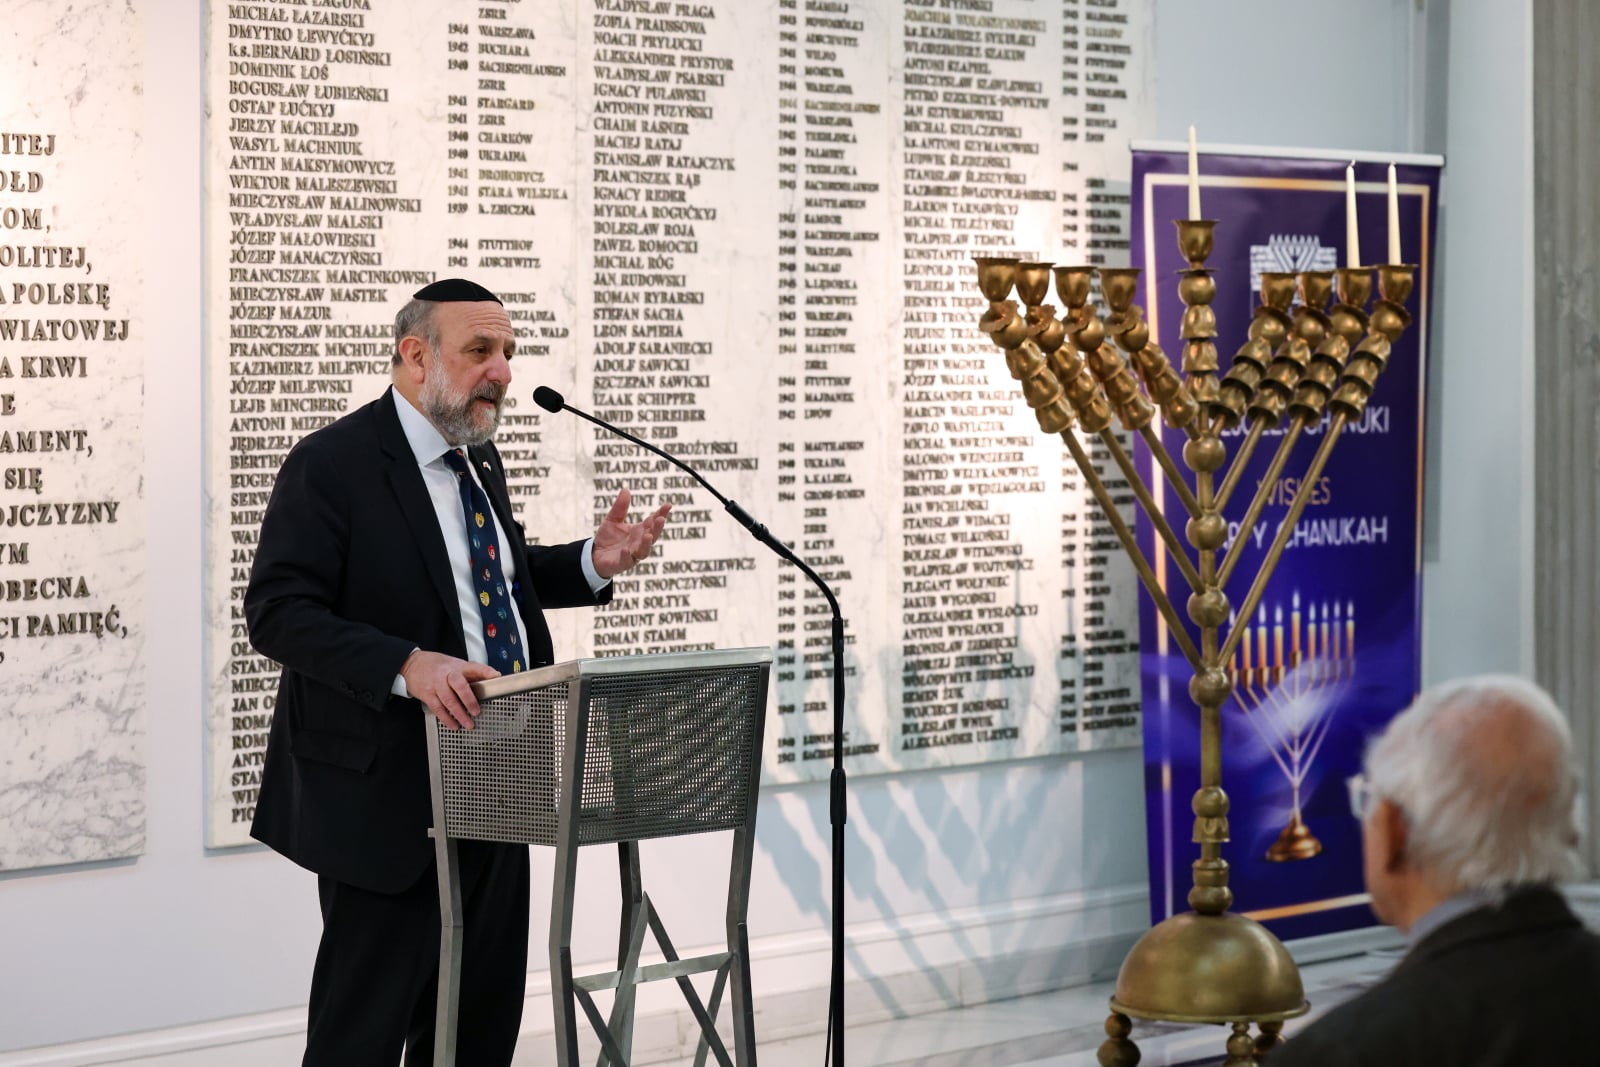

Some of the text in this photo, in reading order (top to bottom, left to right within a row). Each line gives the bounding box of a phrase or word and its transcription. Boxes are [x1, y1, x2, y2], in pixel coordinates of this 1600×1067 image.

[229, 4, 288, 22] MICHAŁ
[292, 9, 365, 28] ŁAZARSKI
[675, 7, 716, 19] PRAGA
[228, 23, 293, 42] DMYTRO
[478, 25, 535, 40] WARSZAWA
[593, 31, 637, 47] NOACH
[326, 49, 391, 66] ŁOSIŃSKI
[478, 43, 530, 58] BUCHARA
[594, 49, 734, 71] ALEKSANDER PRYSTOR
[229, 61, 296, 79] DOMINIK
[675, 71, 725, 86] PSARSKI
[229, 80, 389, 103] BOGUSŁAW ŁUBIEŃSKI
[593, 83, 641, 98] IGNACY
[229, 99, 276, 114] OSTAP
[477, 97, 536, 111] STARGARD
[594, 100, 649, 115] ANTONIN
[229, 117, 359, 137] JERZY MACHLEJD
[1, 133, 56, 156] ITEJ
[230, 136, 363, 156] WASYL MACHNIUK
[594, 135, 682, 151] MACIEJ RATAJ
[478, 149, 527, 162] UKRAINA
[593, 152, 736, 170] STANISŁAW RATAJCZYK
[230, 155, 396, 175] ANTIN MAKSYMOWYCZ
[229, 174, 397, 194] WIKTOR MALESZEWSKI
[478, 169, 545, 183] DROHOBYCZ
[478, 186, 513, 198] STARA
[593, 187, 686, 202] IGNACY REDER
[229, 193, 422, 213] MIECZYSŁAW MALINOWSKI
[0, 207, 51, 233] OM,
[230, 212, 383, 230] WŁADYSŁAW MALSKI
[230, 230, 276, 245] JÓZEF
[664, 223, 695, 237] ROJA
[0, 245, 93, 275] OLITEJ,
[230, 249, 382, 266] JÓZEF MANACZYŃSKI
[478, 256, 541, 268] AUSCHWITZ
[229, 268, 437, 285] FRANCISZEK MARCINKOWSKI
[593, 273, 686, 287] JAN RUDOWSKI
[12, 283, 110, 310] POLSKĘ
[230, 287, 388, 302] MIECZYSŁAW MASTEK
[593, 291, 705, 304] ROMAN RYBARSKI
[229, 305, 332, 320] JÓZEF MAZUR
[593, 307, 684, 320] STEFAN SACHA
[0, 319, 130, 341] WIATOWEJ
[230, 324, 322, 339] MIECZYSŁAW
[229, 343, 320, 357] FRANCISZEK
[21, 356, 88, 378] KRWI
[230, 361, 390, 376] KAZIMIERZ MILEWICZ
[593, 360, 690, 372] ADOLF SAWICKI
[230, 379, 353, 394] JÓZEF MILEWSKI
[230, 397, 348, 413] LEJB MINCBERG
[637, 393, 696, 405] SCHIPPER
[230, 417, 286, 432] ANTONI
[229, 436, 292, 451] JĘDRZEJ
[5, 467, 43, 494] SIĘ
[594, 477, 658, 492] WOJCIECH
[1256, 476, 1331, 506] WISES
[662, 558, 756, 575] SMOCZKIEWICZ
[0, 576, 90, 602] BECNA
[27, 604, 128, 639] PAMIĘĆ,
[593, 613, 652, 629] ZYGMUNT
[593, 627, 687, 647] ROMAN STAMM
